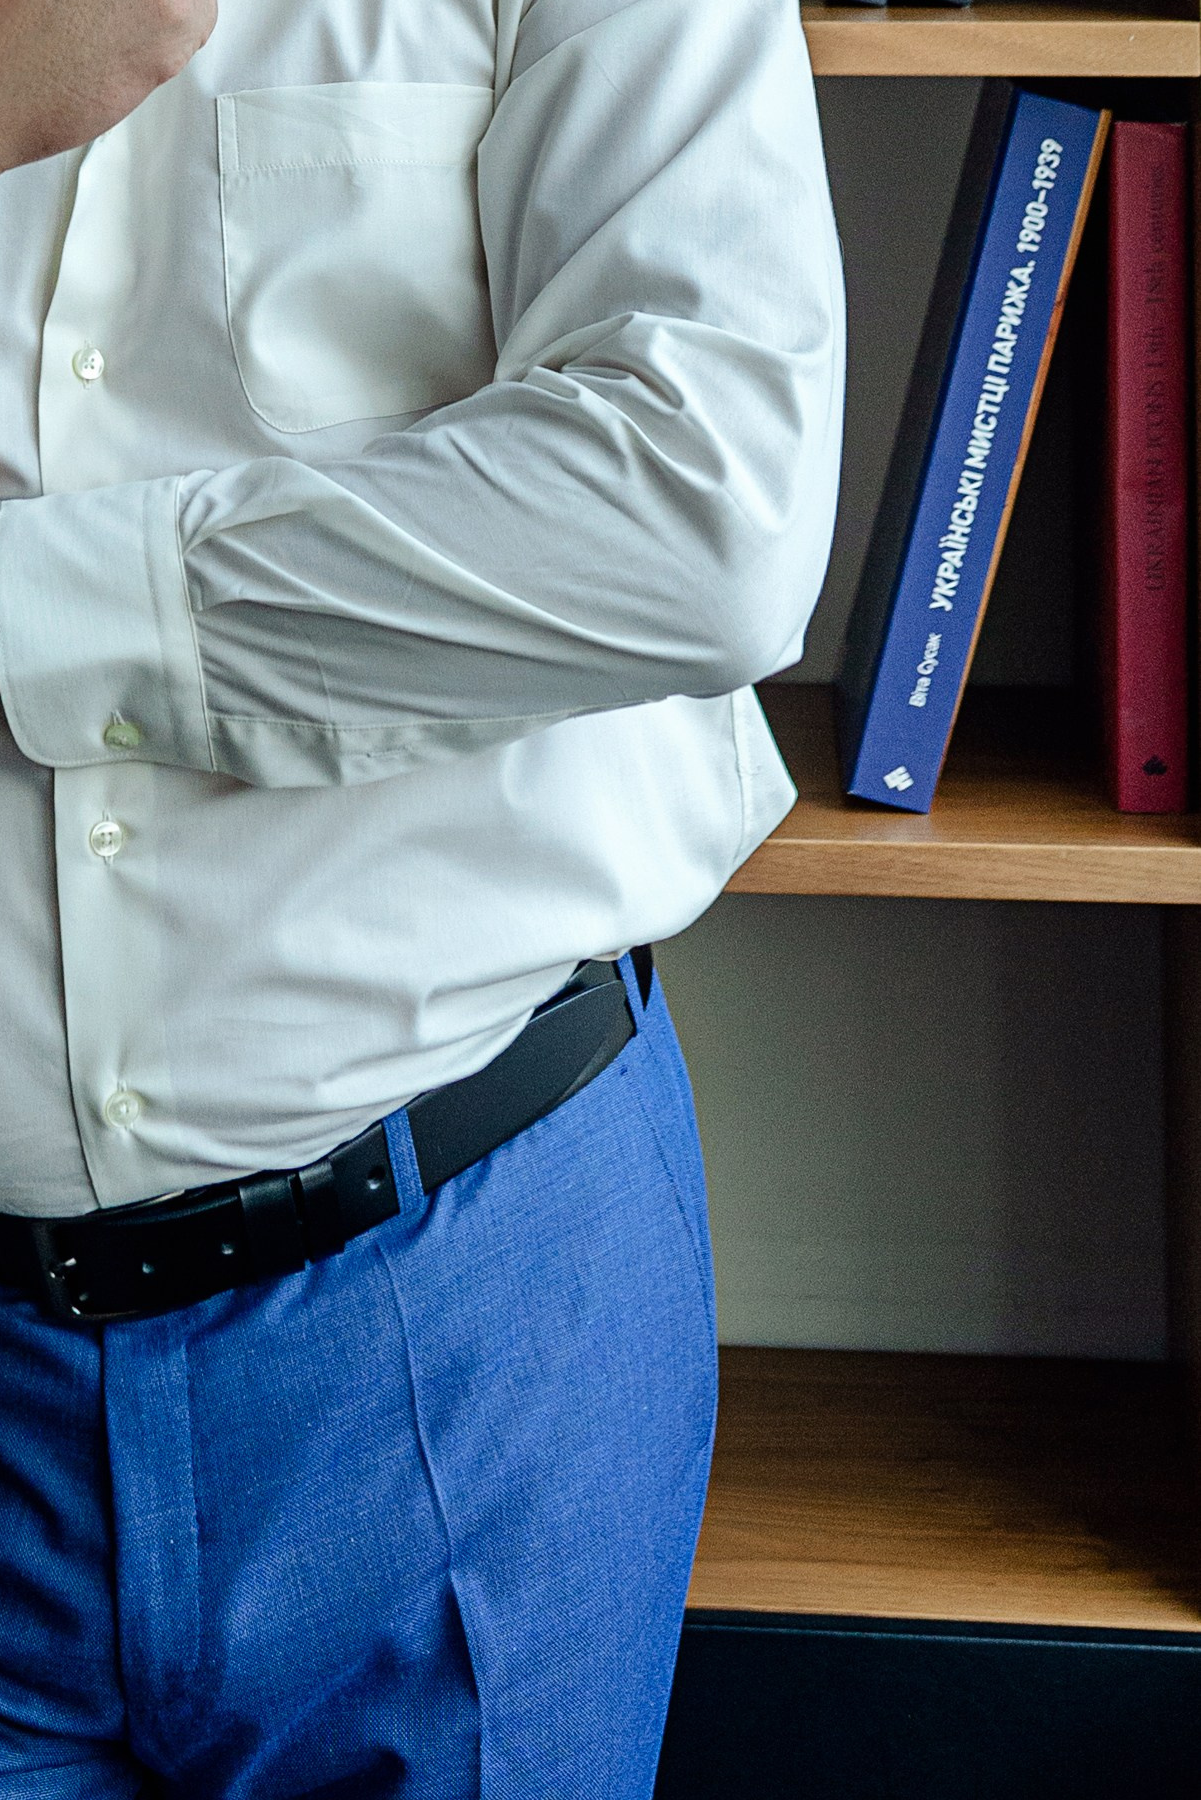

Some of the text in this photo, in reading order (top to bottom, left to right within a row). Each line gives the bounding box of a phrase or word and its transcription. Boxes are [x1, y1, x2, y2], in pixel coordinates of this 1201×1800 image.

[929, 470, 984, 611] УКРАЇНСЬКІ
[964, 375, 1009, 469] МИСТЦІ
[987, 261, 1035, 374] ПАРИЖА.
[1145, 459, 1165, 591] UKRAINIAN
